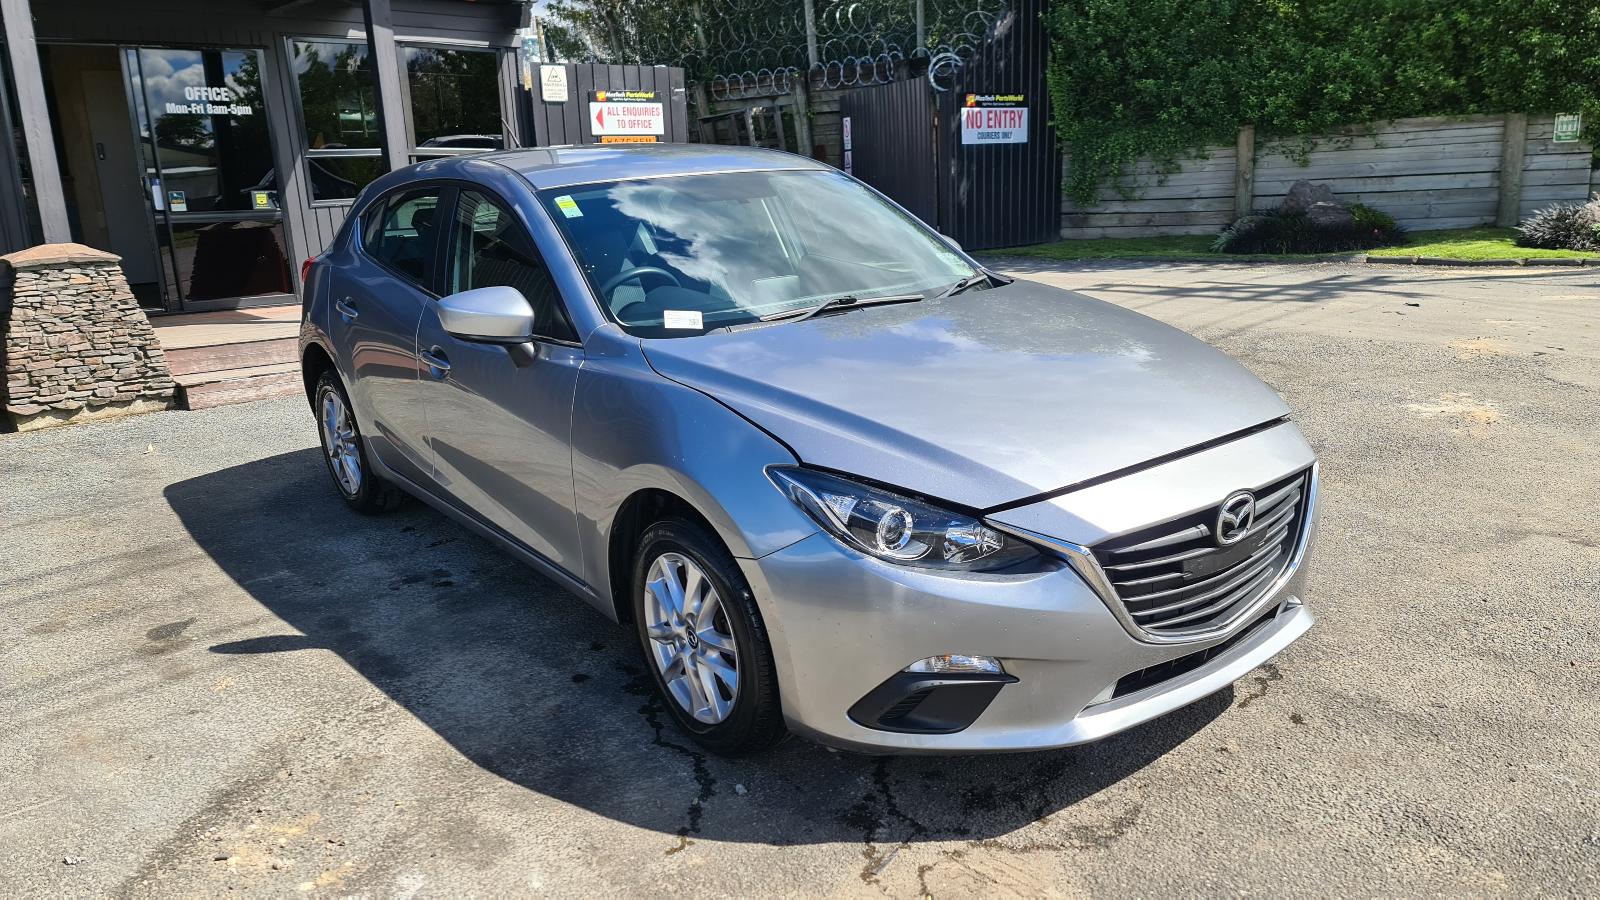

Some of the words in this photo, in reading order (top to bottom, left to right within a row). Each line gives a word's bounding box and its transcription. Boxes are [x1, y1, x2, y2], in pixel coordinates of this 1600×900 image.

[184, 86, 230, 102] OFFICE
[165, 102, 204, 114] Mon-Fri
[206, 104, 252, 115] 8am-5pm
[607, 107, 620, 116] ALL
[622, 107, 660, 116] ENQUIRIES
[616, 119, 626, 129] TO
[628, 119, 653, 129] OFFICE
[967, 110, 983, 129] NO
[987, 110, 1023, 128] ENTRY
[977, 131, 1000, 139] COURIERS
[1001, 131, 1012, 139] ONLY
